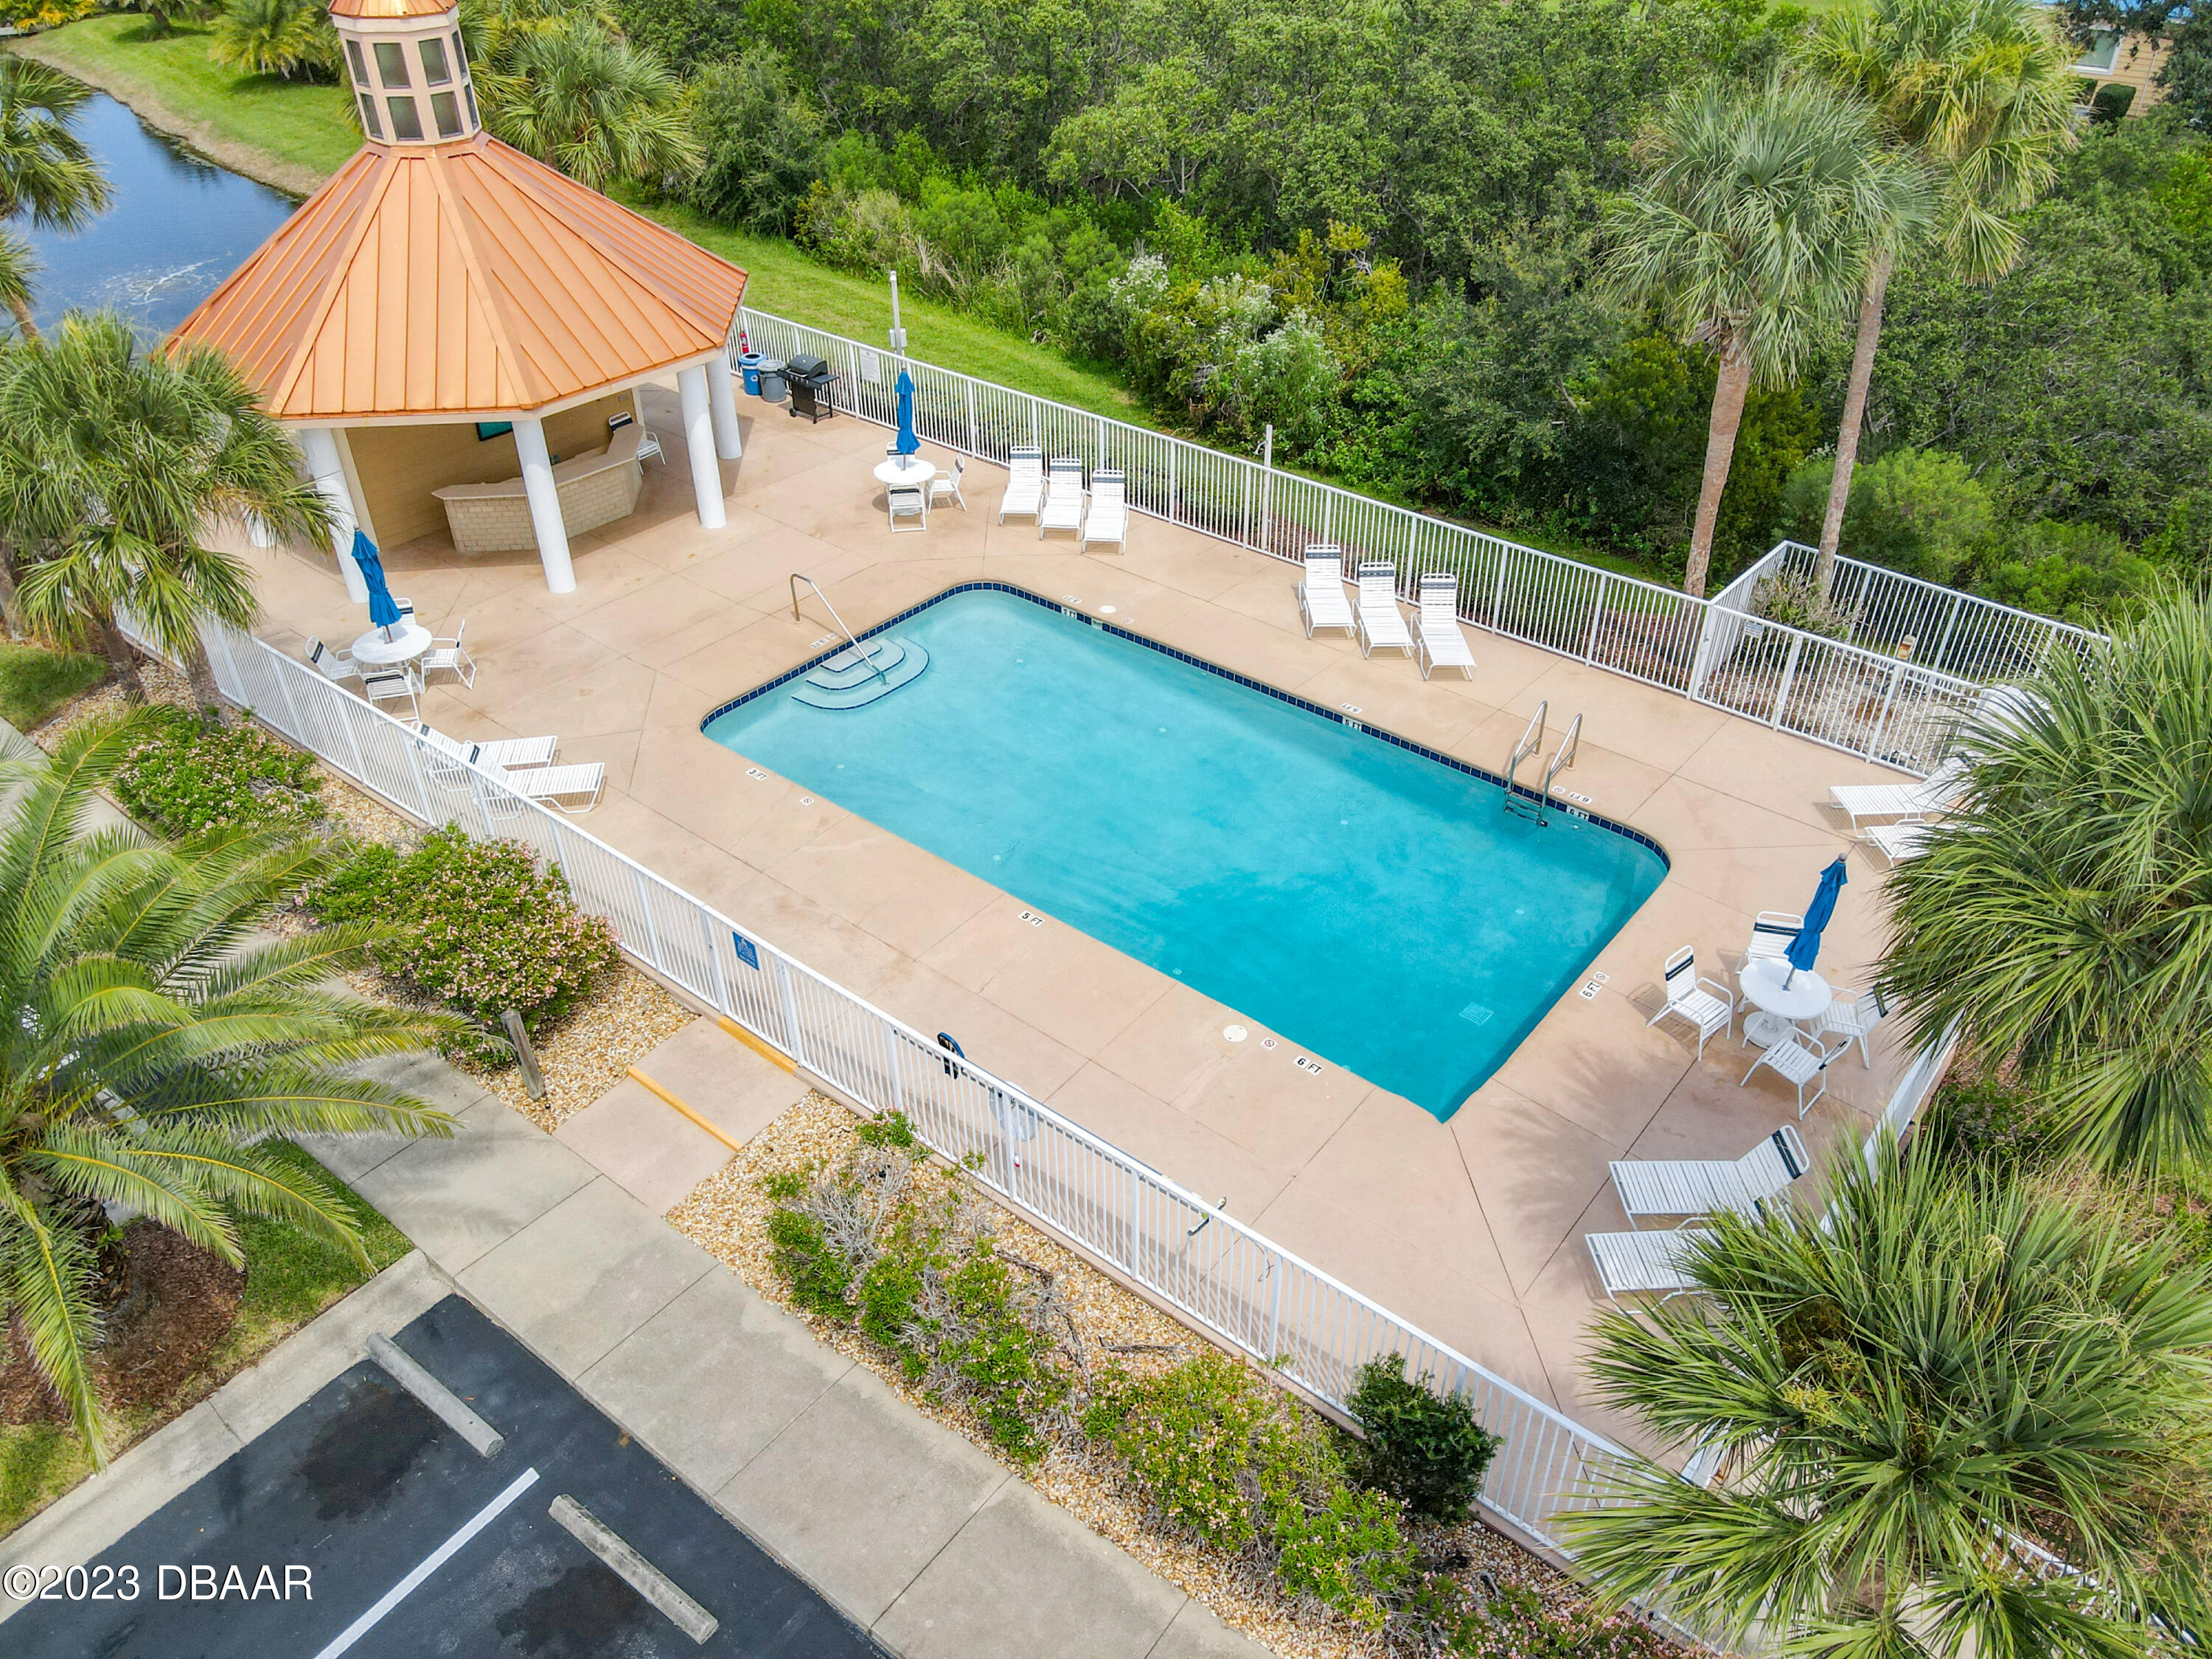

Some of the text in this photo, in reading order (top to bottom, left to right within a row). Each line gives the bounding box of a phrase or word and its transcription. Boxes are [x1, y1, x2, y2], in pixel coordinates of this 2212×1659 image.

[1029, 917, 1043, 925] FT
[1587, 981, 1600, 992] FT
[1307, 1062, 1323, 1074] FT
